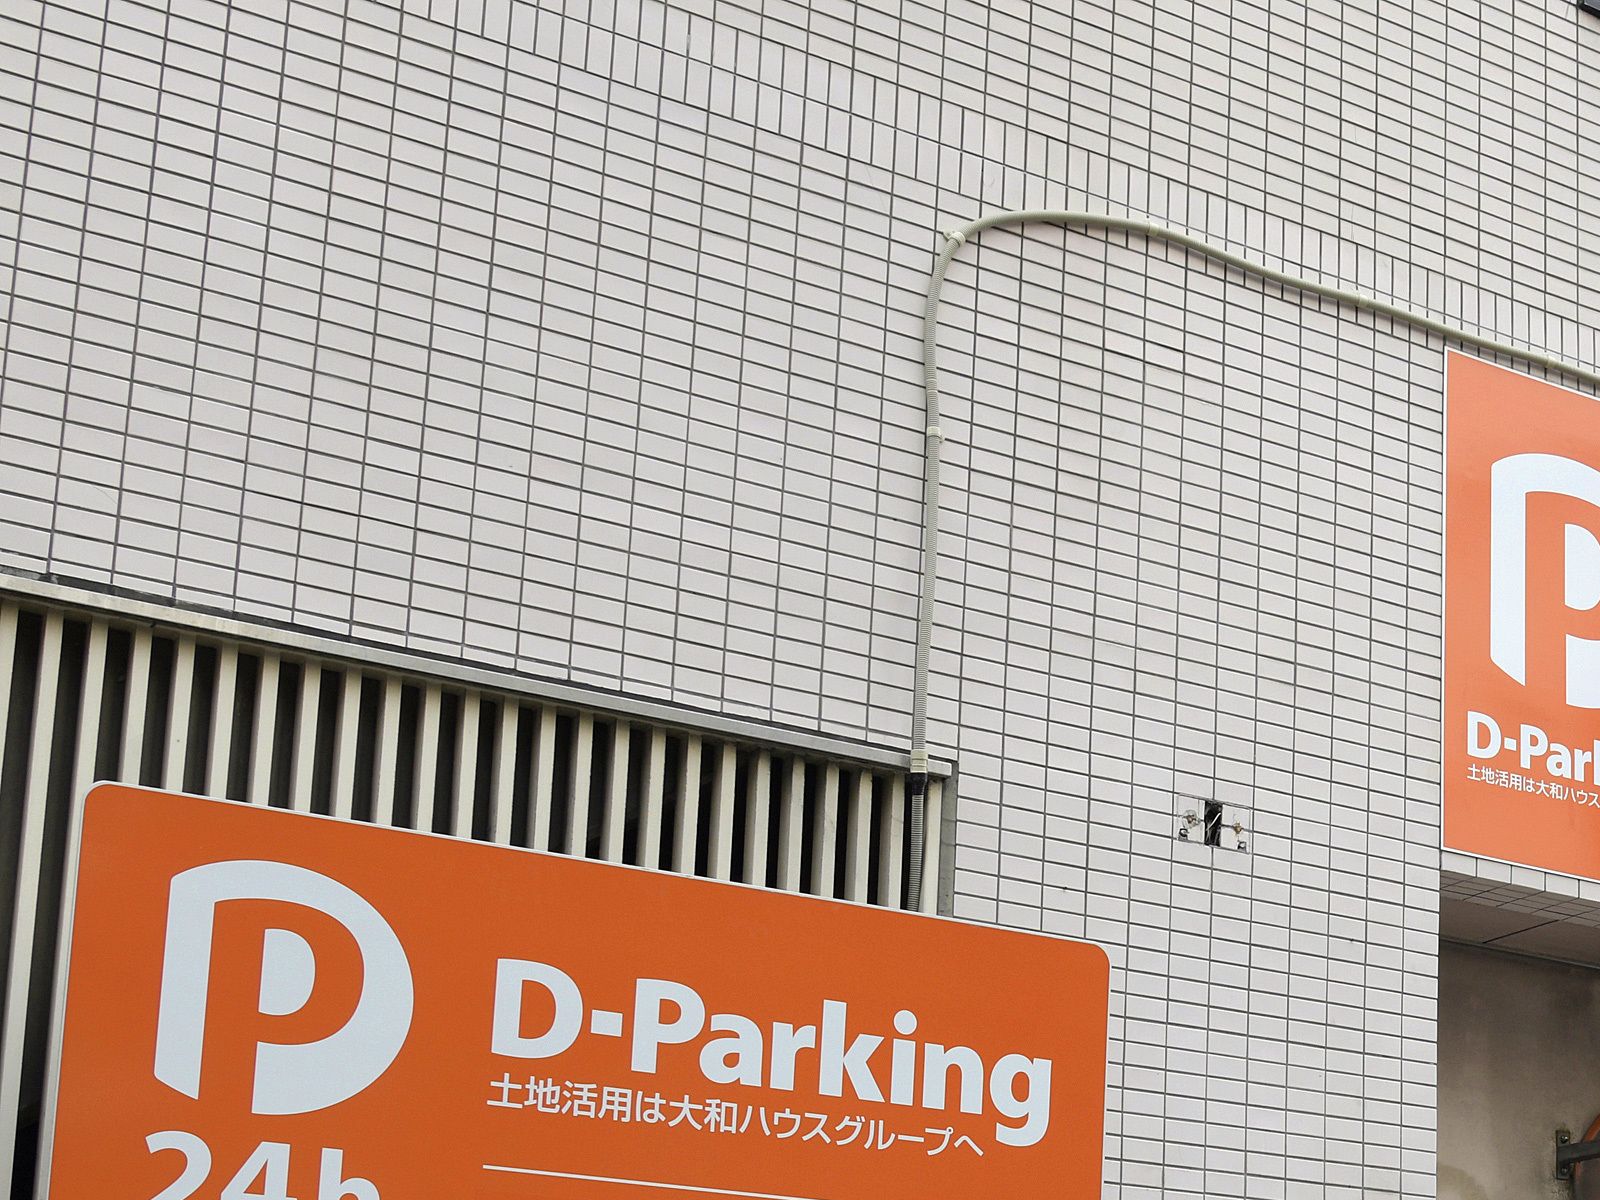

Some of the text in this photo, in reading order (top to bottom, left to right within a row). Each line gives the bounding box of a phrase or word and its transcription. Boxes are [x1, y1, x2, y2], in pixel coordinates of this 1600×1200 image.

[486, 1072, 986, 1157] 土地活用は大和ハウスグループへ
[491, 957, 1053, 1147] D-Parking
